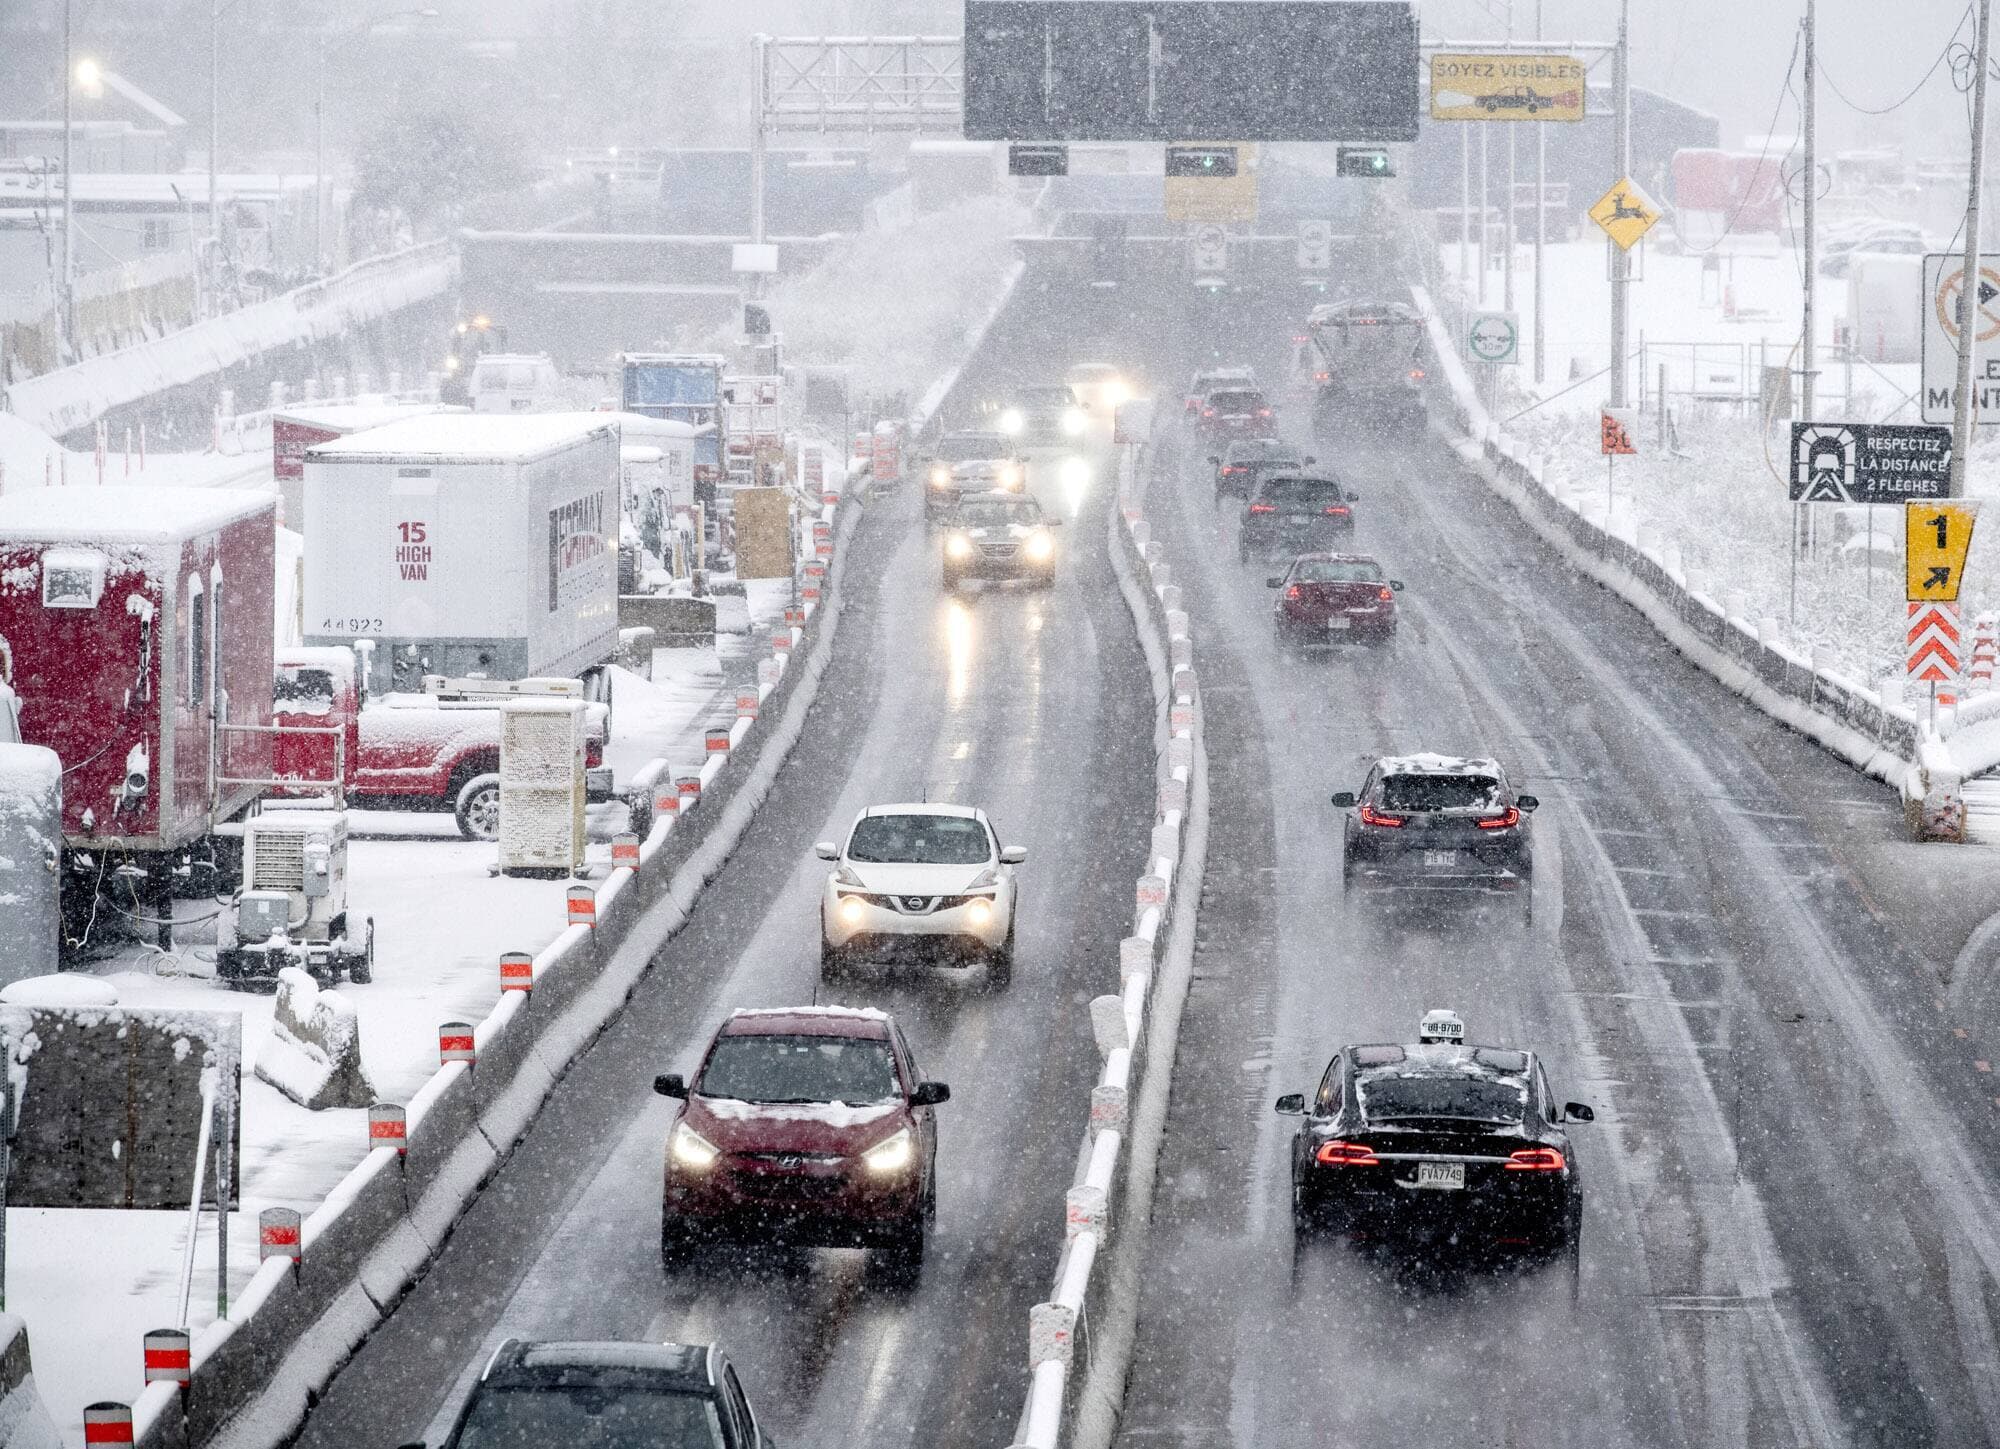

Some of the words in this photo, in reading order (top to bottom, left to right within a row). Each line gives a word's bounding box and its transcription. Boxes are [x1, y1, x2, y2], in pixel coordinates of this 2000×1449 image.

[1435, 62, 1495, 78] SOYEZ
[1501, 63, 1582, 79] VISIBLES
[1928, 387, 2000, 409] MNT
[1867, 437, 1940, 453] RESPECTEZ
[1860, 457, 1877, 471] LA
[1881, 459, 1946, 473] DISTANCE
[1867, 479, 1877, 491] 2
[397, 521, 426, 543] 15
[1926, 515, 1947, 549] 1
[395, 545, 432, 563] HIGH
[400, 564, 428, 581] VAN
[1421, 1168, 1462, 1181] FVA7749
